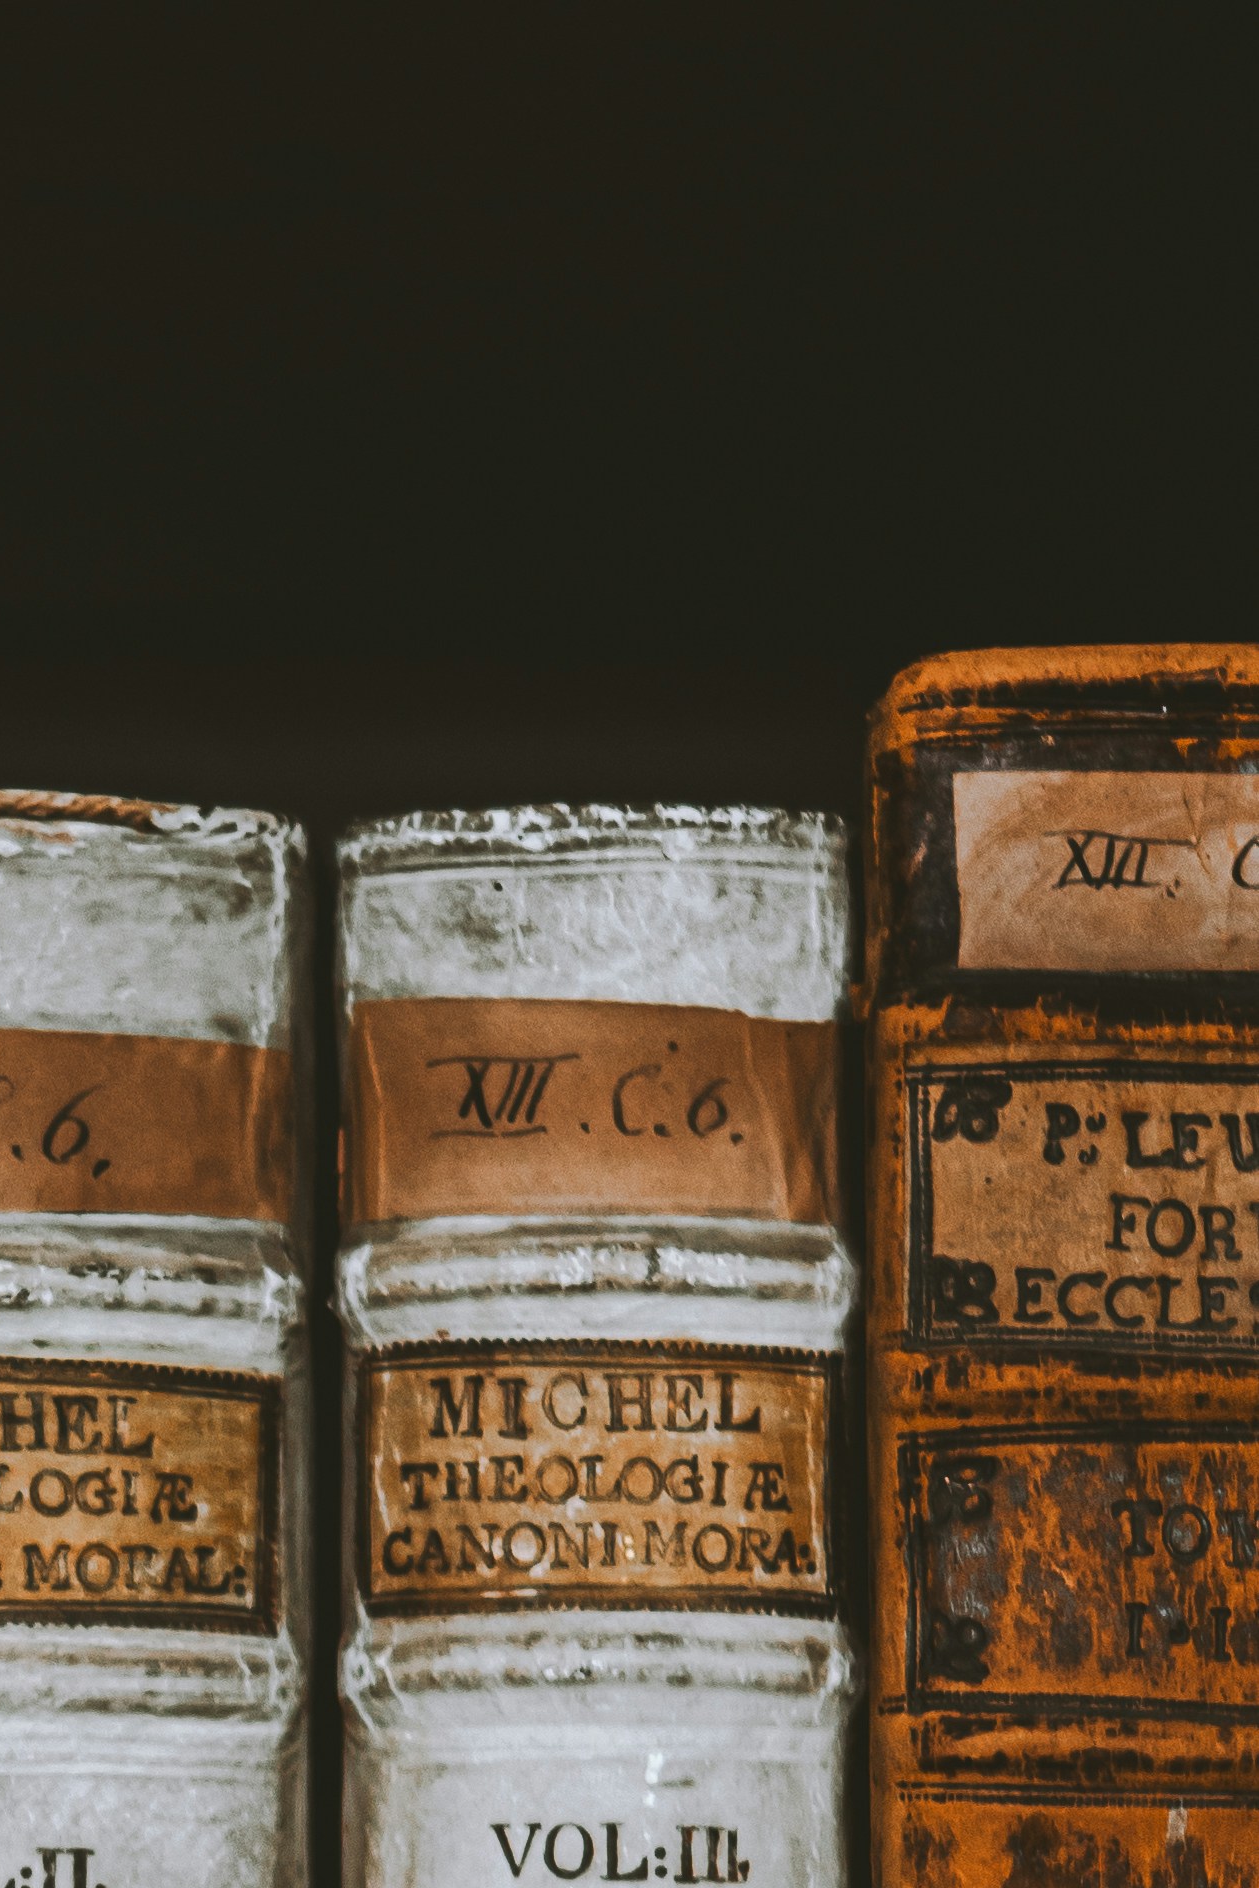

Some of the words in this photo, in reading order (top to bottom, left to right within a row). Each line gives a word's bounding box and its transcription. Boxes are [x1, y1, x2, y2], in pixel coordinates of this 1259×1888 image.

[1104, 1193, 1259, 1262] FOR
[1013, 1266, 1259, 1334] ECCLE
[427, 1371, 762, 1440] MICHEL
